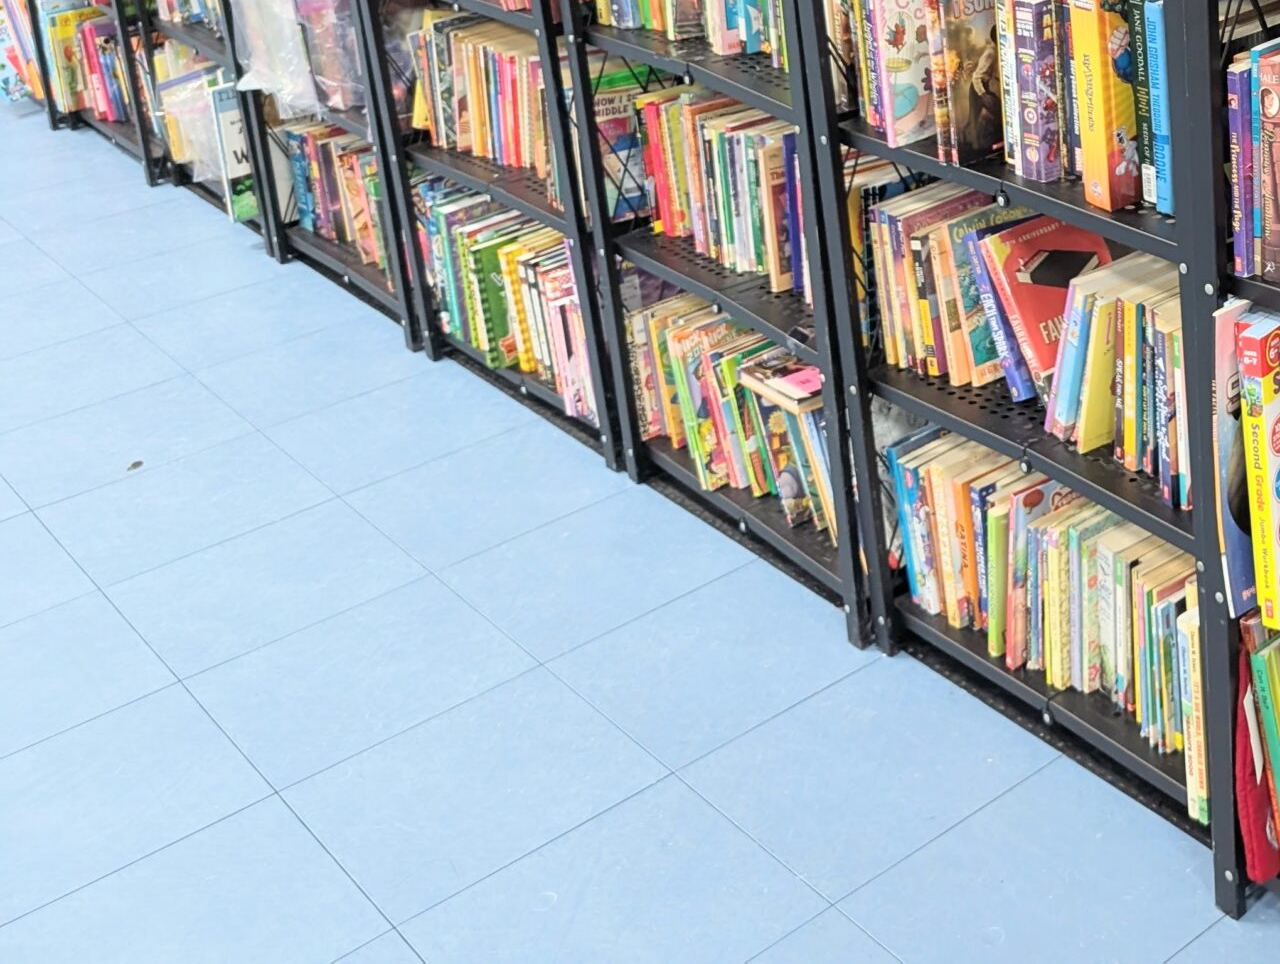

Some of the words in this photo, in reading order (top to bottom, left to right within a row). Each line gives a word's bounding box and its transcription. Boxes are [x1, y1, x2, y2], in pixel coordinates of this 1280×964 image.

[1133, 9, 1141, 33] JANE
[1146, 17, 1157, 44] JOHN
[1135, 33, 1145, 82] GOODALL
[1149, 46, 1159, 90] GRISHAM
[1151, 93, 1163, 135] THEODORE
[1156, 139, 1167, 184] BOONE
[1018, 222, 1059, 245] ANNIVERSARY
[1244, 355, 1258, 365] 6-7
[1251, 423, 1263, 470] Second
[1255, 471, 1265, 513] Grade
[1259, 516, 1268, 544] Jumbo
[1261, 545, 1271, 589] Workbook
